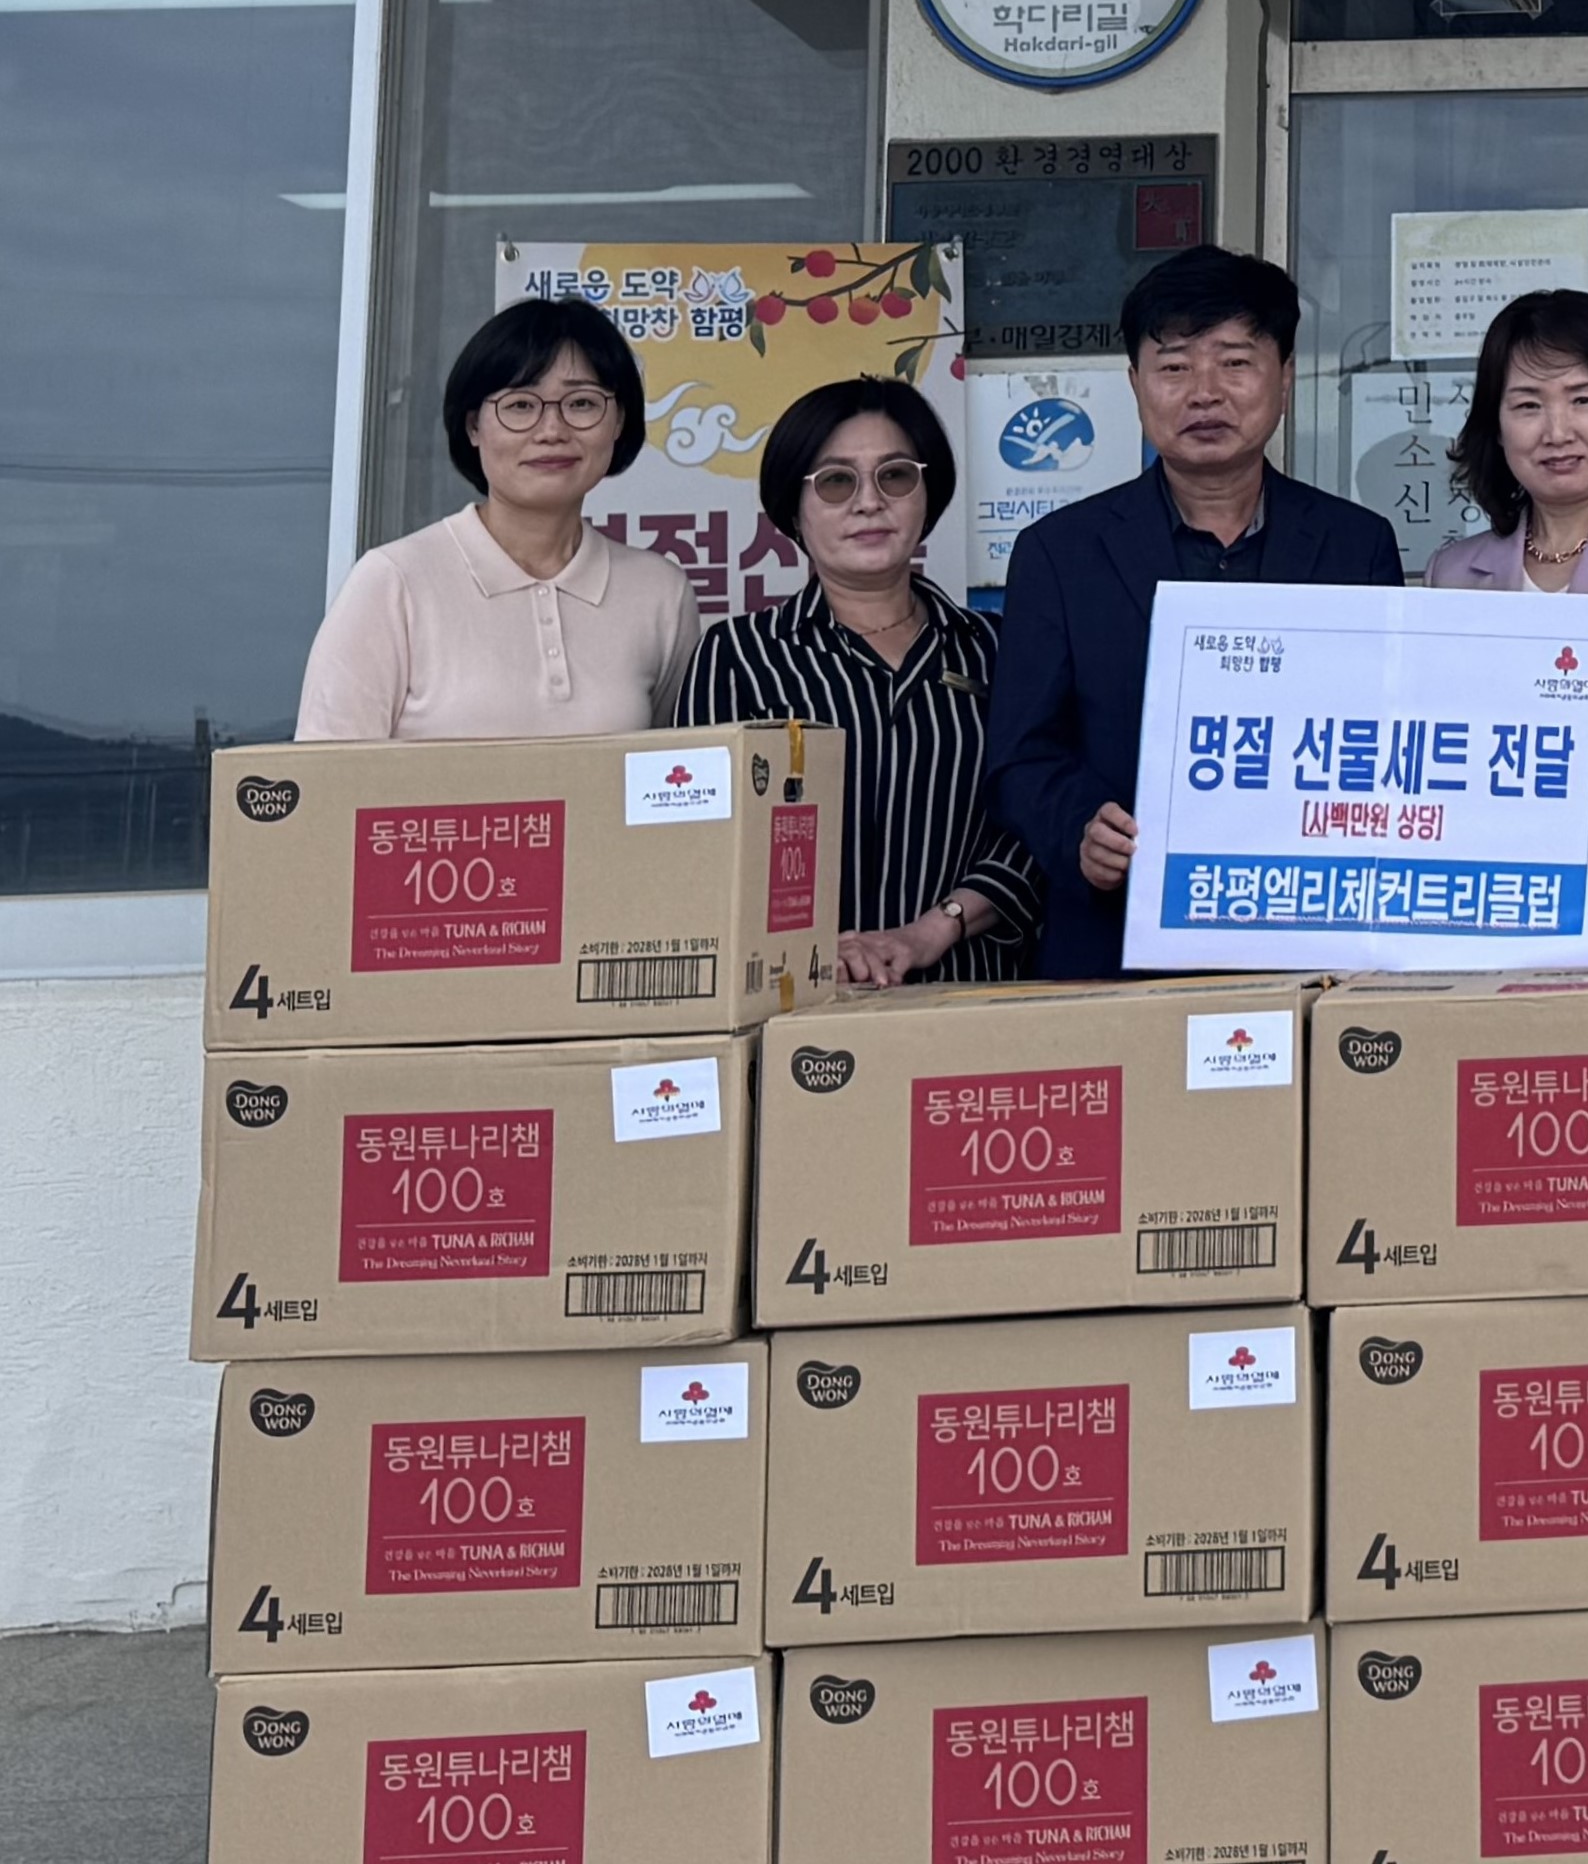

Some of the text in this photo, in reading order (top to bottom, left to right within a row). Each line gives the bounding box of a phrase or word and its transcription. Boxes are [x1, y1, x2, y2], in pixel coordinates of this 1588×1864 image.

[993, 2, 1130, 35] 학다리길
[1003, 34, 1119, 53] Hakdari-gil
[906, 142, 1194, 177] 2000 환경경영대상
[525, 268, 680, 302] 새로운 도약
[690, 307, 748, 340] 함평
[1188, 713, 1576, 800] 명절 선물세트 전달
[245, 789, 292, 804] DONG
[251, 802, 288, 816] WON
[1301, 800, 1445, 842] [사백만원 상당]
[367, 813, 551, 855] 동원튜나리챔
[404, 858, 517, 905] 100호
[1187, 863, 1562, 929] 함평엘리체컨트리클럽
[445, 922, 487, 940] TUNA
[489, 923, 499, 937] &
[1348, 1040, 1394, 1056] DONG
[801, 1059, 846, 1075] DONG
[1353, 1053, 1389, 1068] WON
[806, 1072, 842, 1086] WON
[234, 1093, 281, 1108] DONG
[924, 1080, 1109, 1125] 동원튜나리챔
[239, 1107, 276, 1122] WON
[356, 1122, 540, 1163] 동원튜나리챔
[961, 1126, 1076, 1177] 100호
[392, 1167, 506, 1214] 100호
[1547, 1176, 1588, 1192] TUNA
[1002, 1193, 1044, 1210] TUNA
[432, 1233, 475, 1249] TUNA
[1369, 1350, 1416, 1364] DONG
[1374, 1363, 1410, 1378] WON
[807, 1375, 853, 1390] DONG
[811, 1389, 849, 1403] WON
[260, 1402, 307, 1418] DONG
[265, 1416, 301, 1430] WON
[930, 1398, 1116, 1443] 동원튜나리챔
[384, 1431, 571, 1472] 동원튜나리챔
[967, 1445, 1083, 1495] 100호
[419, 1476, 536, 1526] 100호
[1009, 1512, 1051, 1529] TUNA
[461, 1544, 503, 1561] TUNA
[506, 1546, 516, 1559] &
[1367, 1665, 1414, 1681] DONG
[1373, 1678, 1409, 1693] WON
[819, 1690, 868, 1705] DONG
[825, 1703, 862, 1718] WON
[252, 1719, 301, 1734] DONG
[947, 1711, 1135, 1757] 동원튜나리챔
[258, 1733, 295, 1749] WON
[379, 1745, 573, 1790] 동원튜나리챔
[984, 1759, 1102, 1810] 100호
[416, 1793, 536, 1845] 100호
[1026, 1828, 1069, 1845] TUNA
